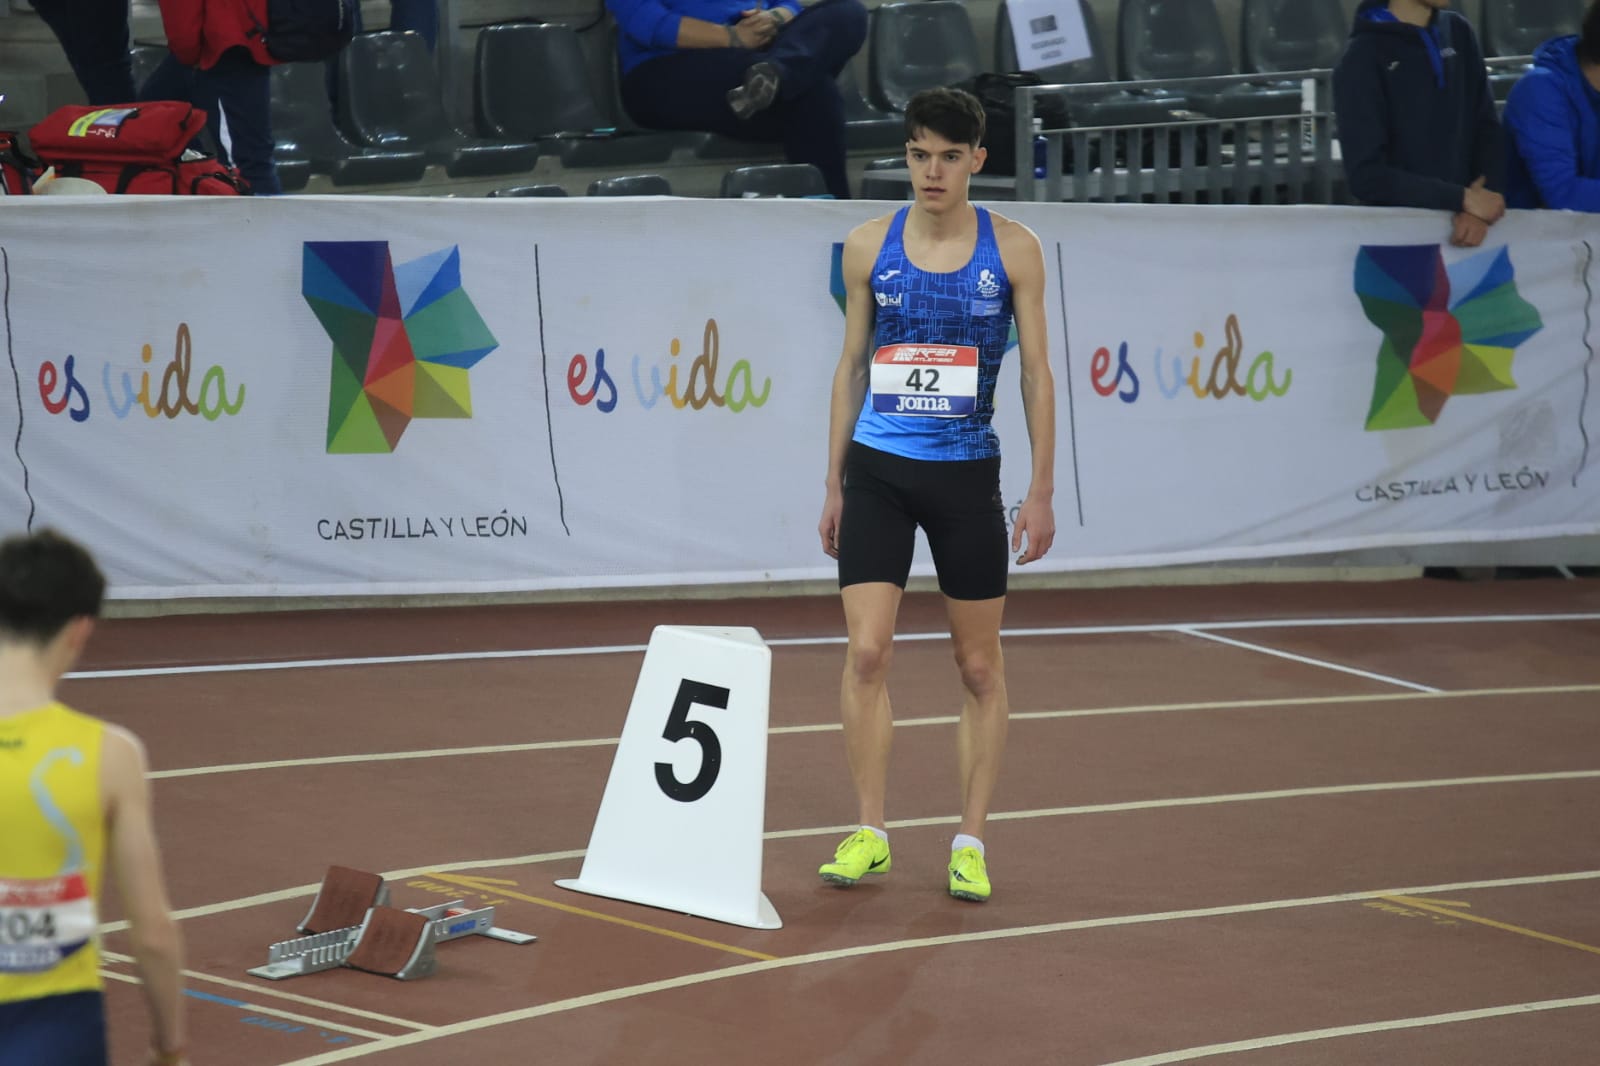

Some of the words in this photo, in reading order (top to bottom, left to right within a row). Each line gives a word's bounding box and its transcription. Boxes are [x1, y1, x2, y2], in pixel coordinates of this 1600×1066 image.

[38, 354, 90, 422] es
[103, 322, 246, 421] vida
[567, 348, 618, 413] es
[631, 318, 772, 413] vida
[905, 368, 940, 392] 42
[1090, 341, 1140, 403] es
[1153, 313, 1293, 402] vida
[1355, 477, 1459, 502] CASTILLA
[1463, 474, 1478, 493] Y
[1484, 466, 1550, 492] LEÓN
[317, 516, 438, 540] CASTILLA
[440, 517, 454, 537] Y
[461, 508, 528, 538] LEÓN
[654, 678, 731, 803] 5
[0, 911, 56, 941] 04
